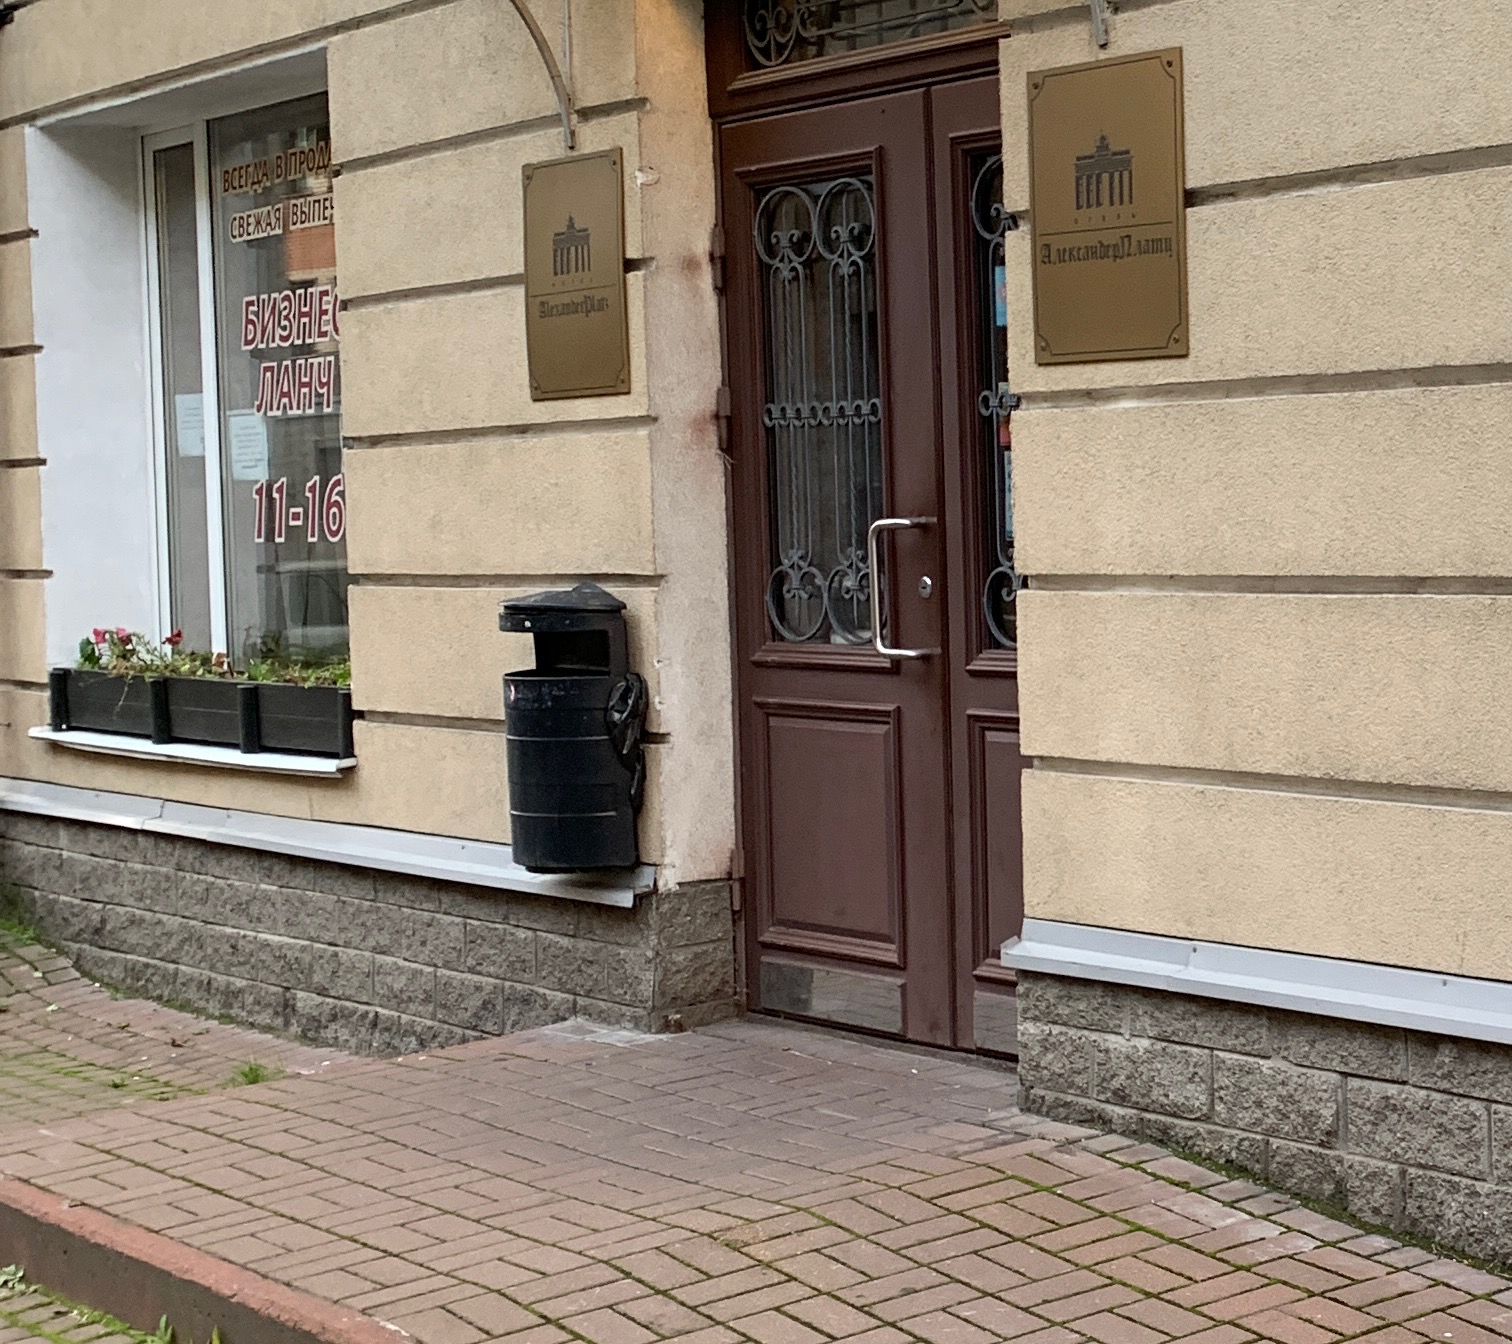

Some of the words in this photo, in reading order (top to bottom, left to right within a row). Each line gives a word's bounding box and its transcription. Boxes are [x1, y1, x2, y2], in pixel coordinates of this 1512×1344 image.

[223, 160, 269, 193] ВСЕГДА
[275, 154, 285, 180] В
[230, 207, 281, 240] СВЕЖАЯ
[254, 356, 335, 417] ЛАНЧ
[252, 474, 346, 543] 11-16
